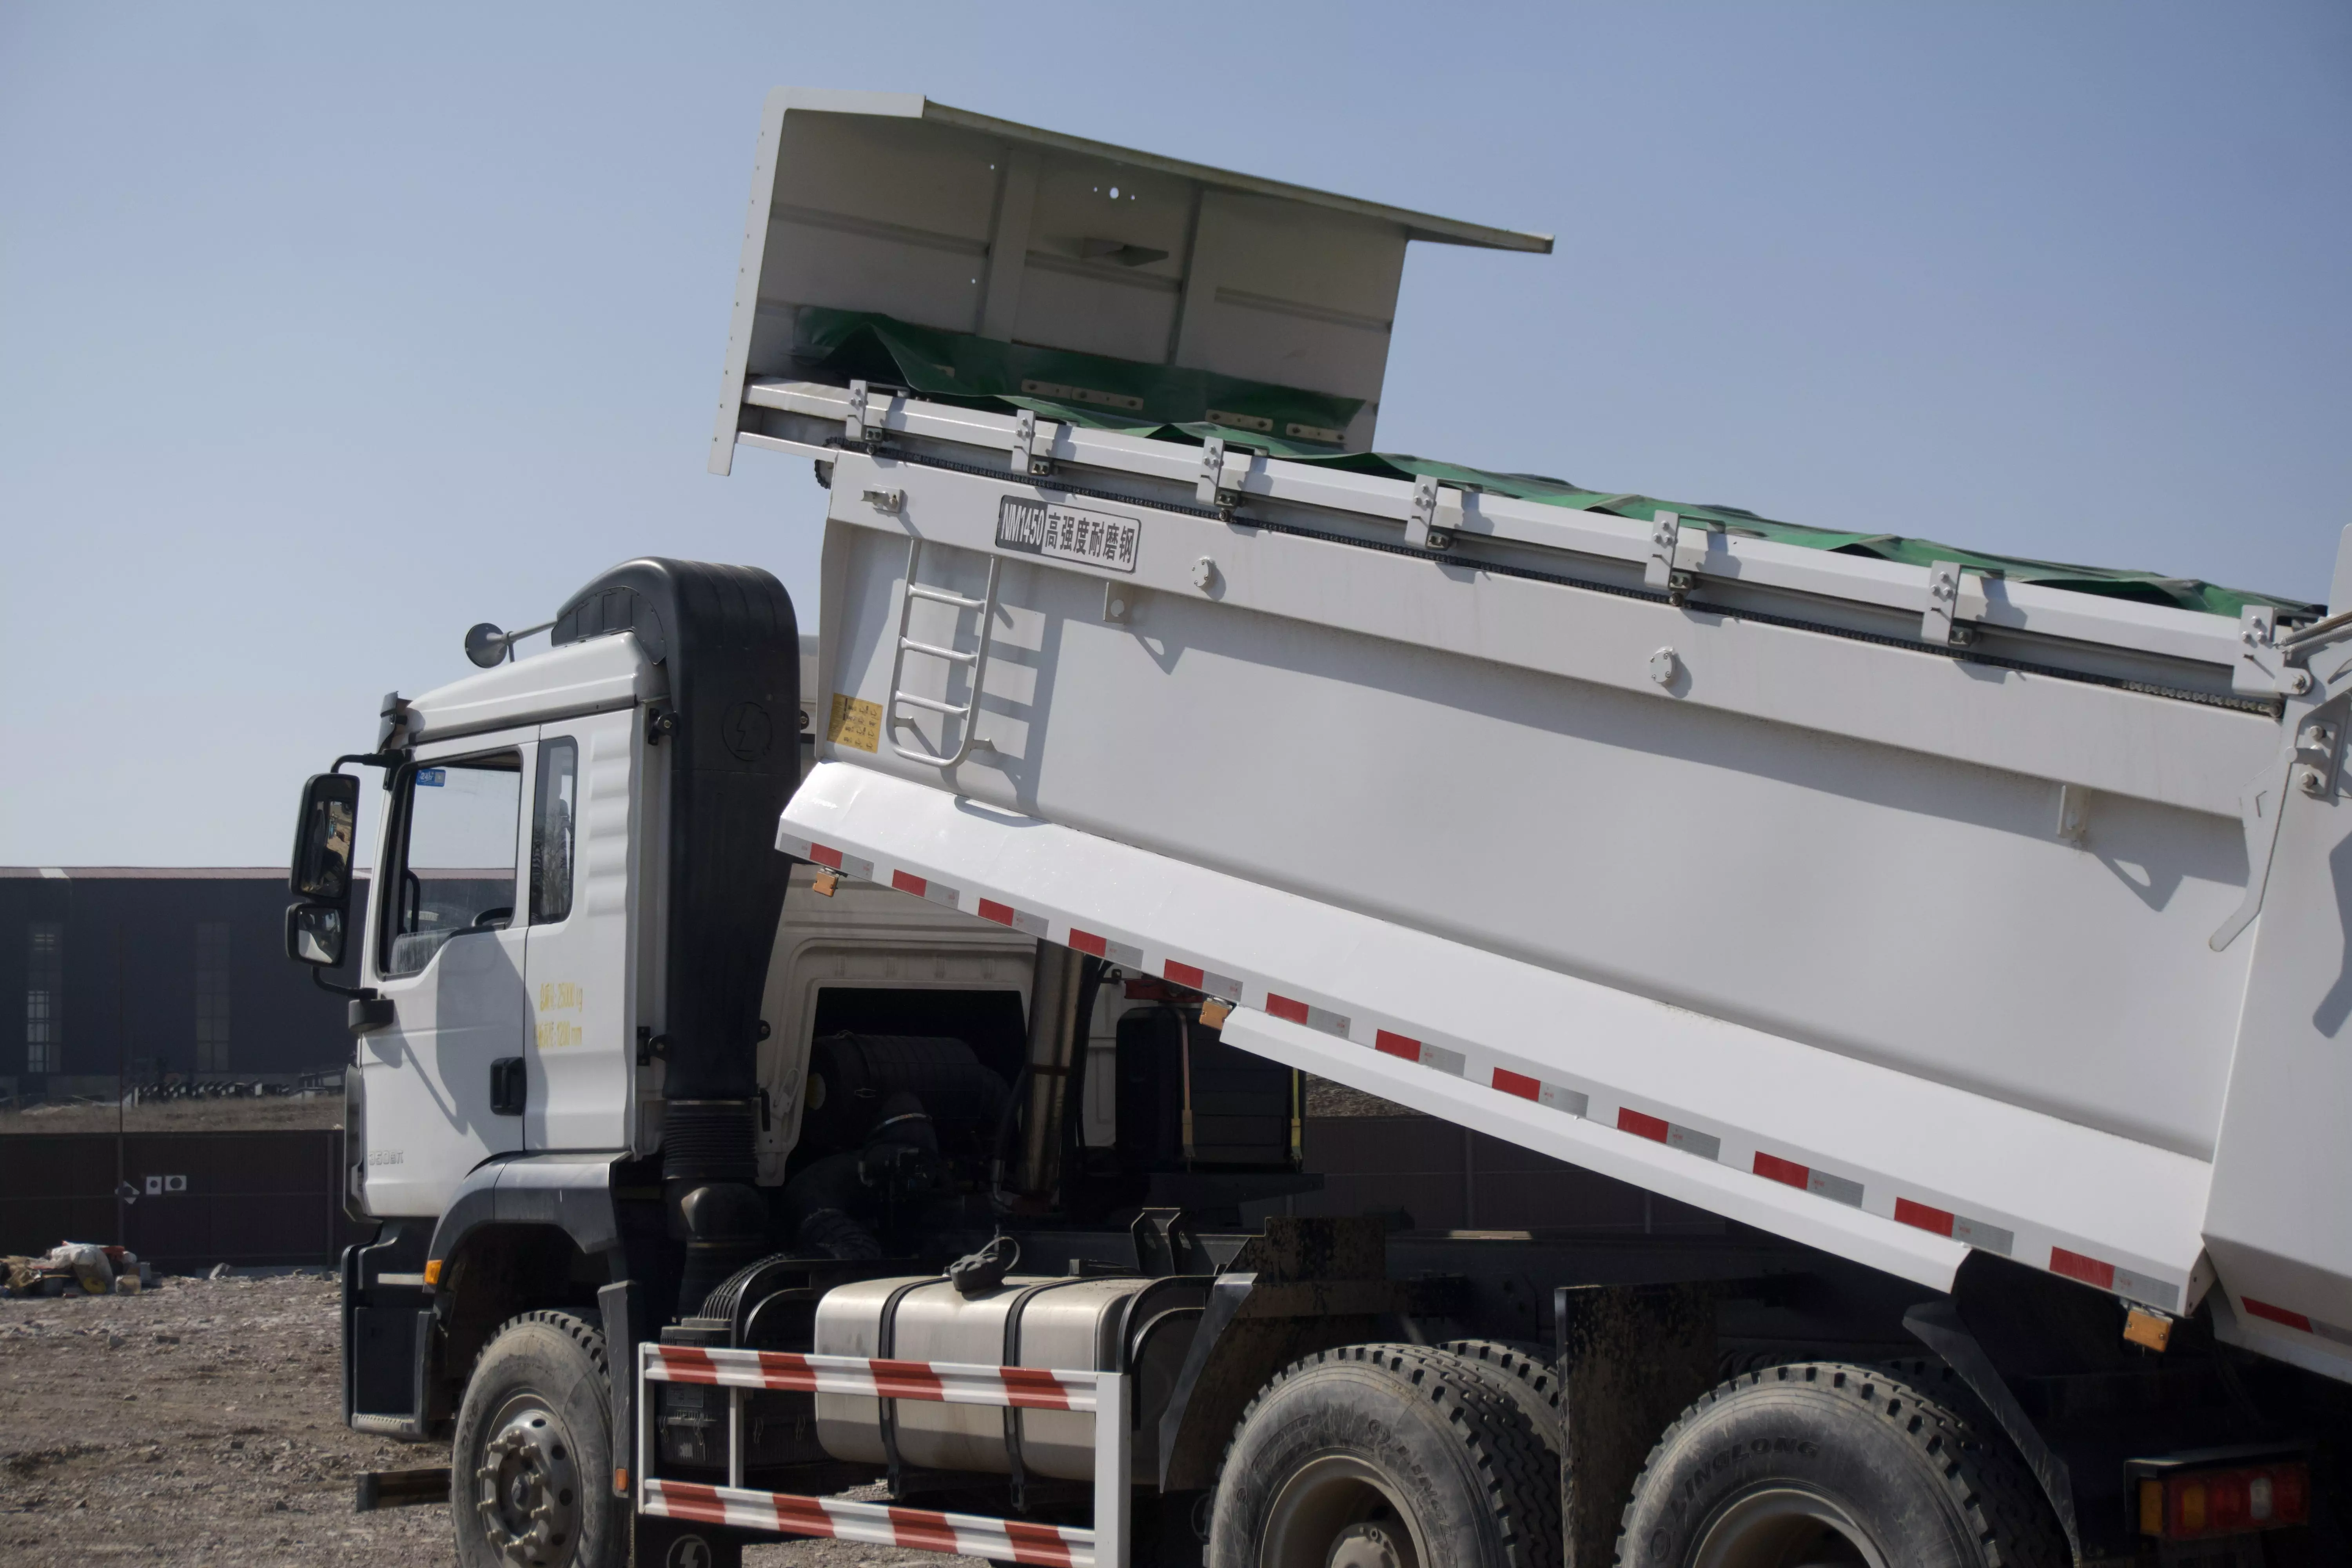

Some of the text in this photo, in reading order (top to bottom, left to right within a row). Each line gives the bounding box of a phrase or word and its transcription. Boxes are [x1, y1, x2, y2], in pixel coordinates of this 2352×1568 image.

[1000, 503, 1135, 564] NM1450 高强度耐磨钢
[1669, 1436, 1821, 1523] LINGLONG
